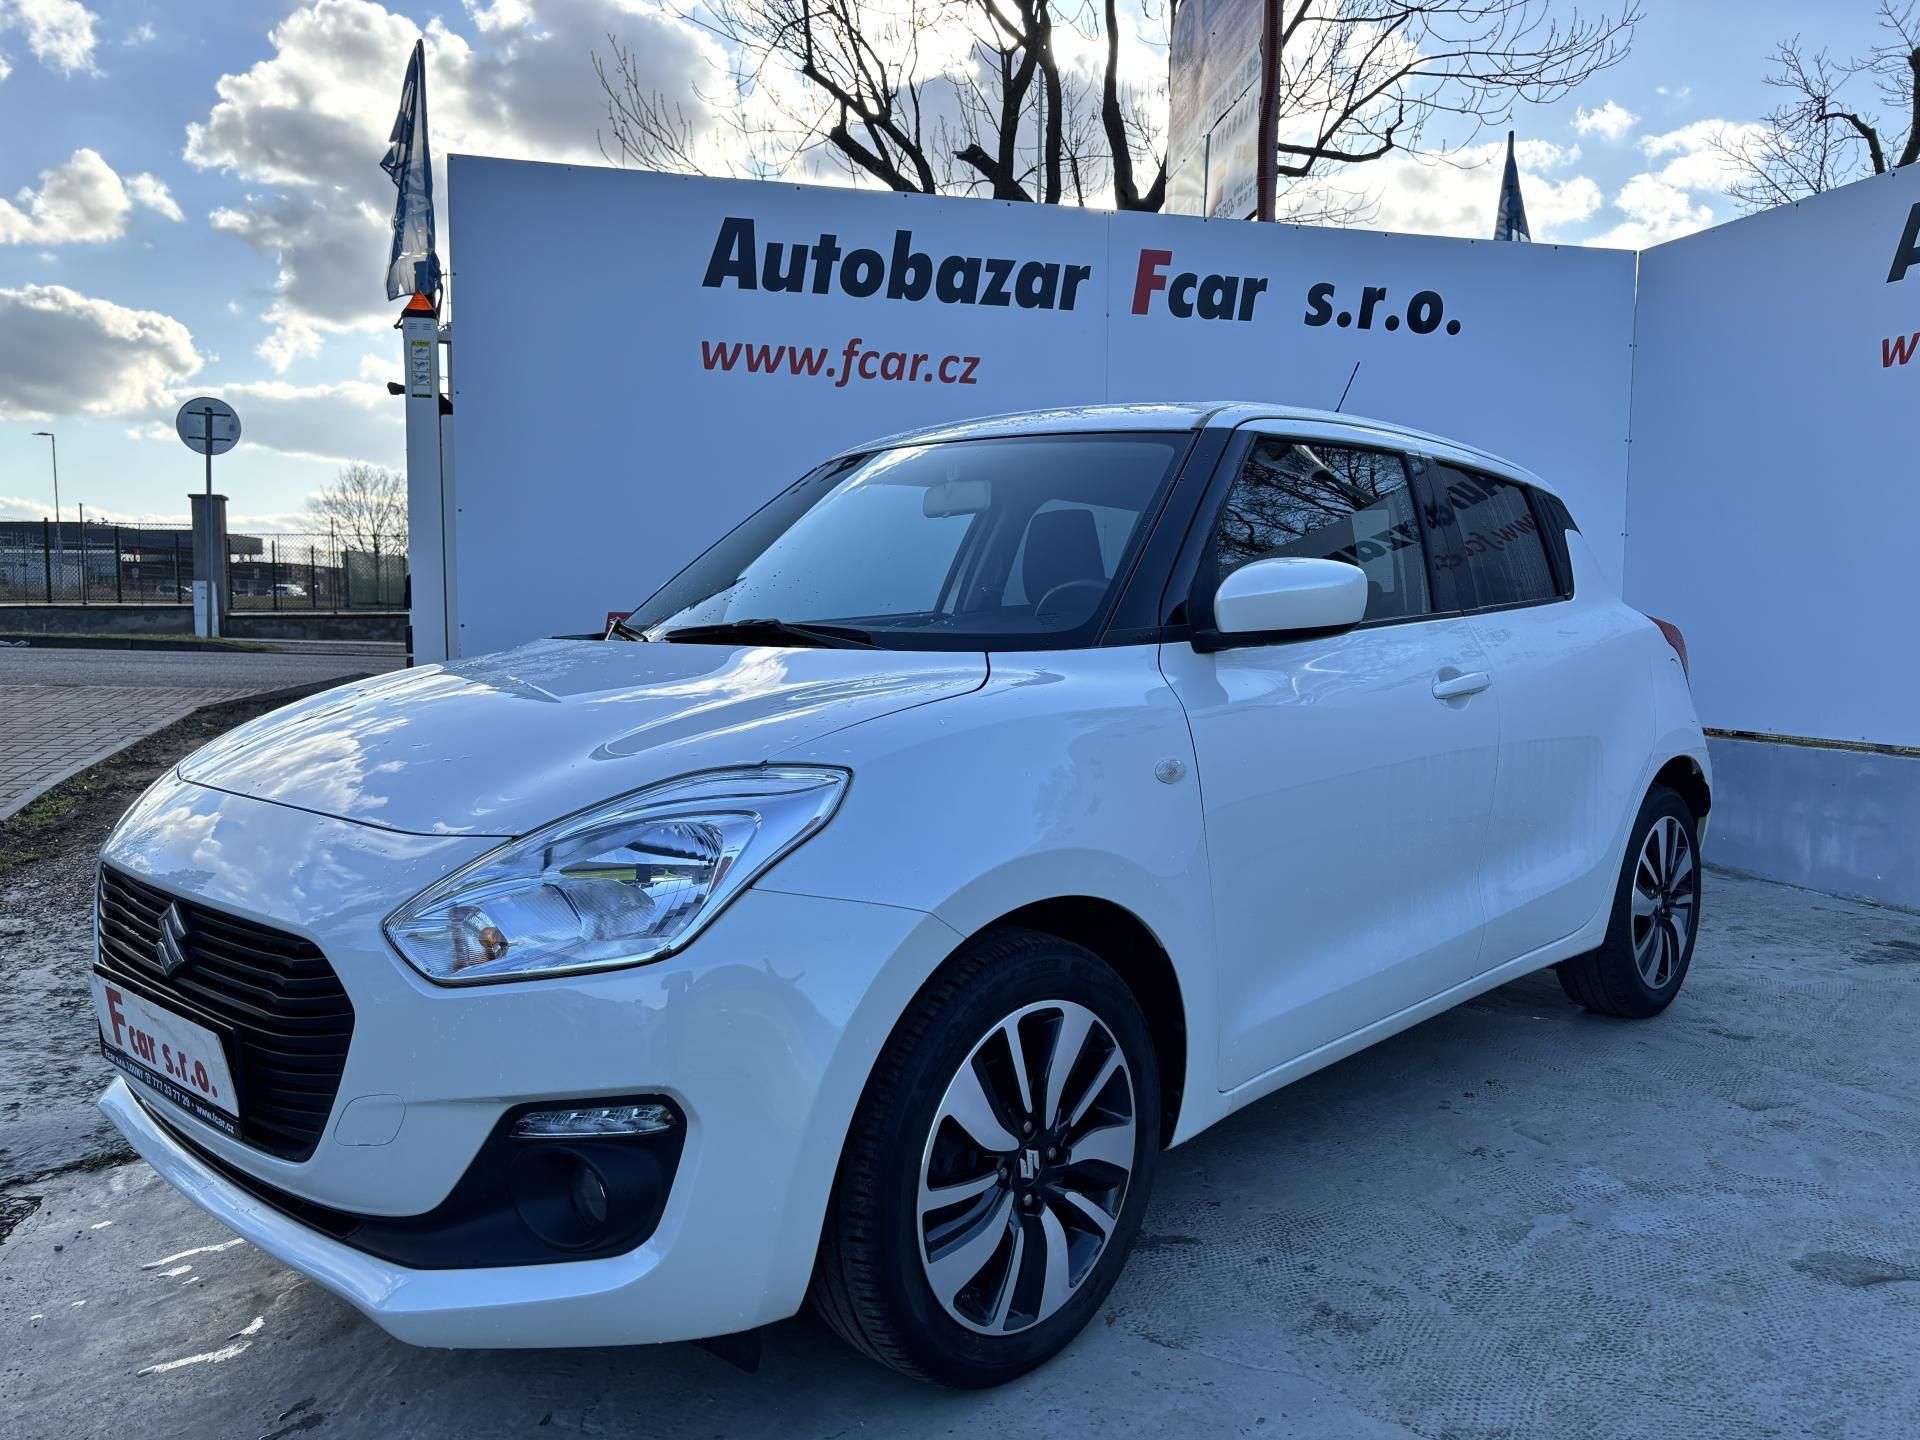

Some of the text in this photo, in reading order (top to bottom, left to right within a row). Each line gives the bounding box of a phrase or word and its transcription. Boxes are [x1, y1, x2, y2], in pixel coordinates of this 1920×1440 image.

[701, 216, 1462, 336] Autobazar Fcar s.r.o.
[702, 338, 980, 388] www.fcar.cz
[151, 1076, 163, 1091] 777
[162, 1043, 218, 1099] s.r.o.
